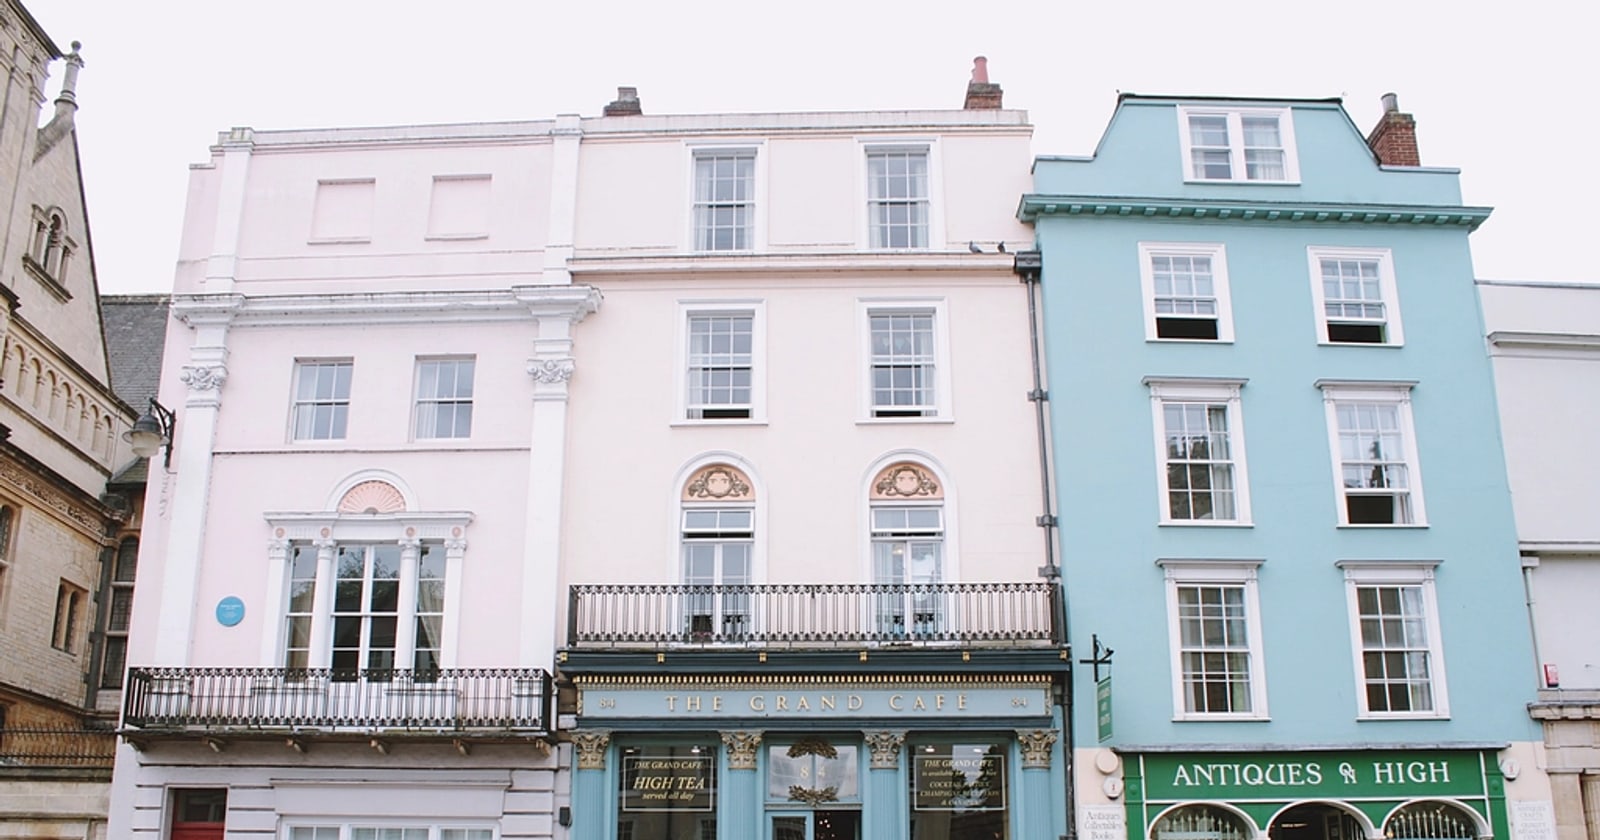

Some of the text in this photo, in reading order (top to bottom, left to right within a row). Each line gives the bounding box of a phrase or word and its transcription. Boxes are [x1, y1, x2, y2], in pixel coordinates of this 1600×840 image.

[599, 697, 616, 709] 84
[665, 695, 723, 711] THE
[750, 695, 864, 711] GRAND
[1010, 697, 1028, 708] 84
[634, 760, 650, 769] THE
[651, 760, 681, 769] GRAND
[924, 759, 942, 768] THE
[1172, 762, 1323, 786] ANTIQUES
[1372, 761, 1451, 784] HIGH
[633, 776, 705, 790] HIGH TEA
[642, 791, 695, 801] served all day
[1086, 811, 1121, 821] Antiques
[1091, 830, 1115, 840] Books
